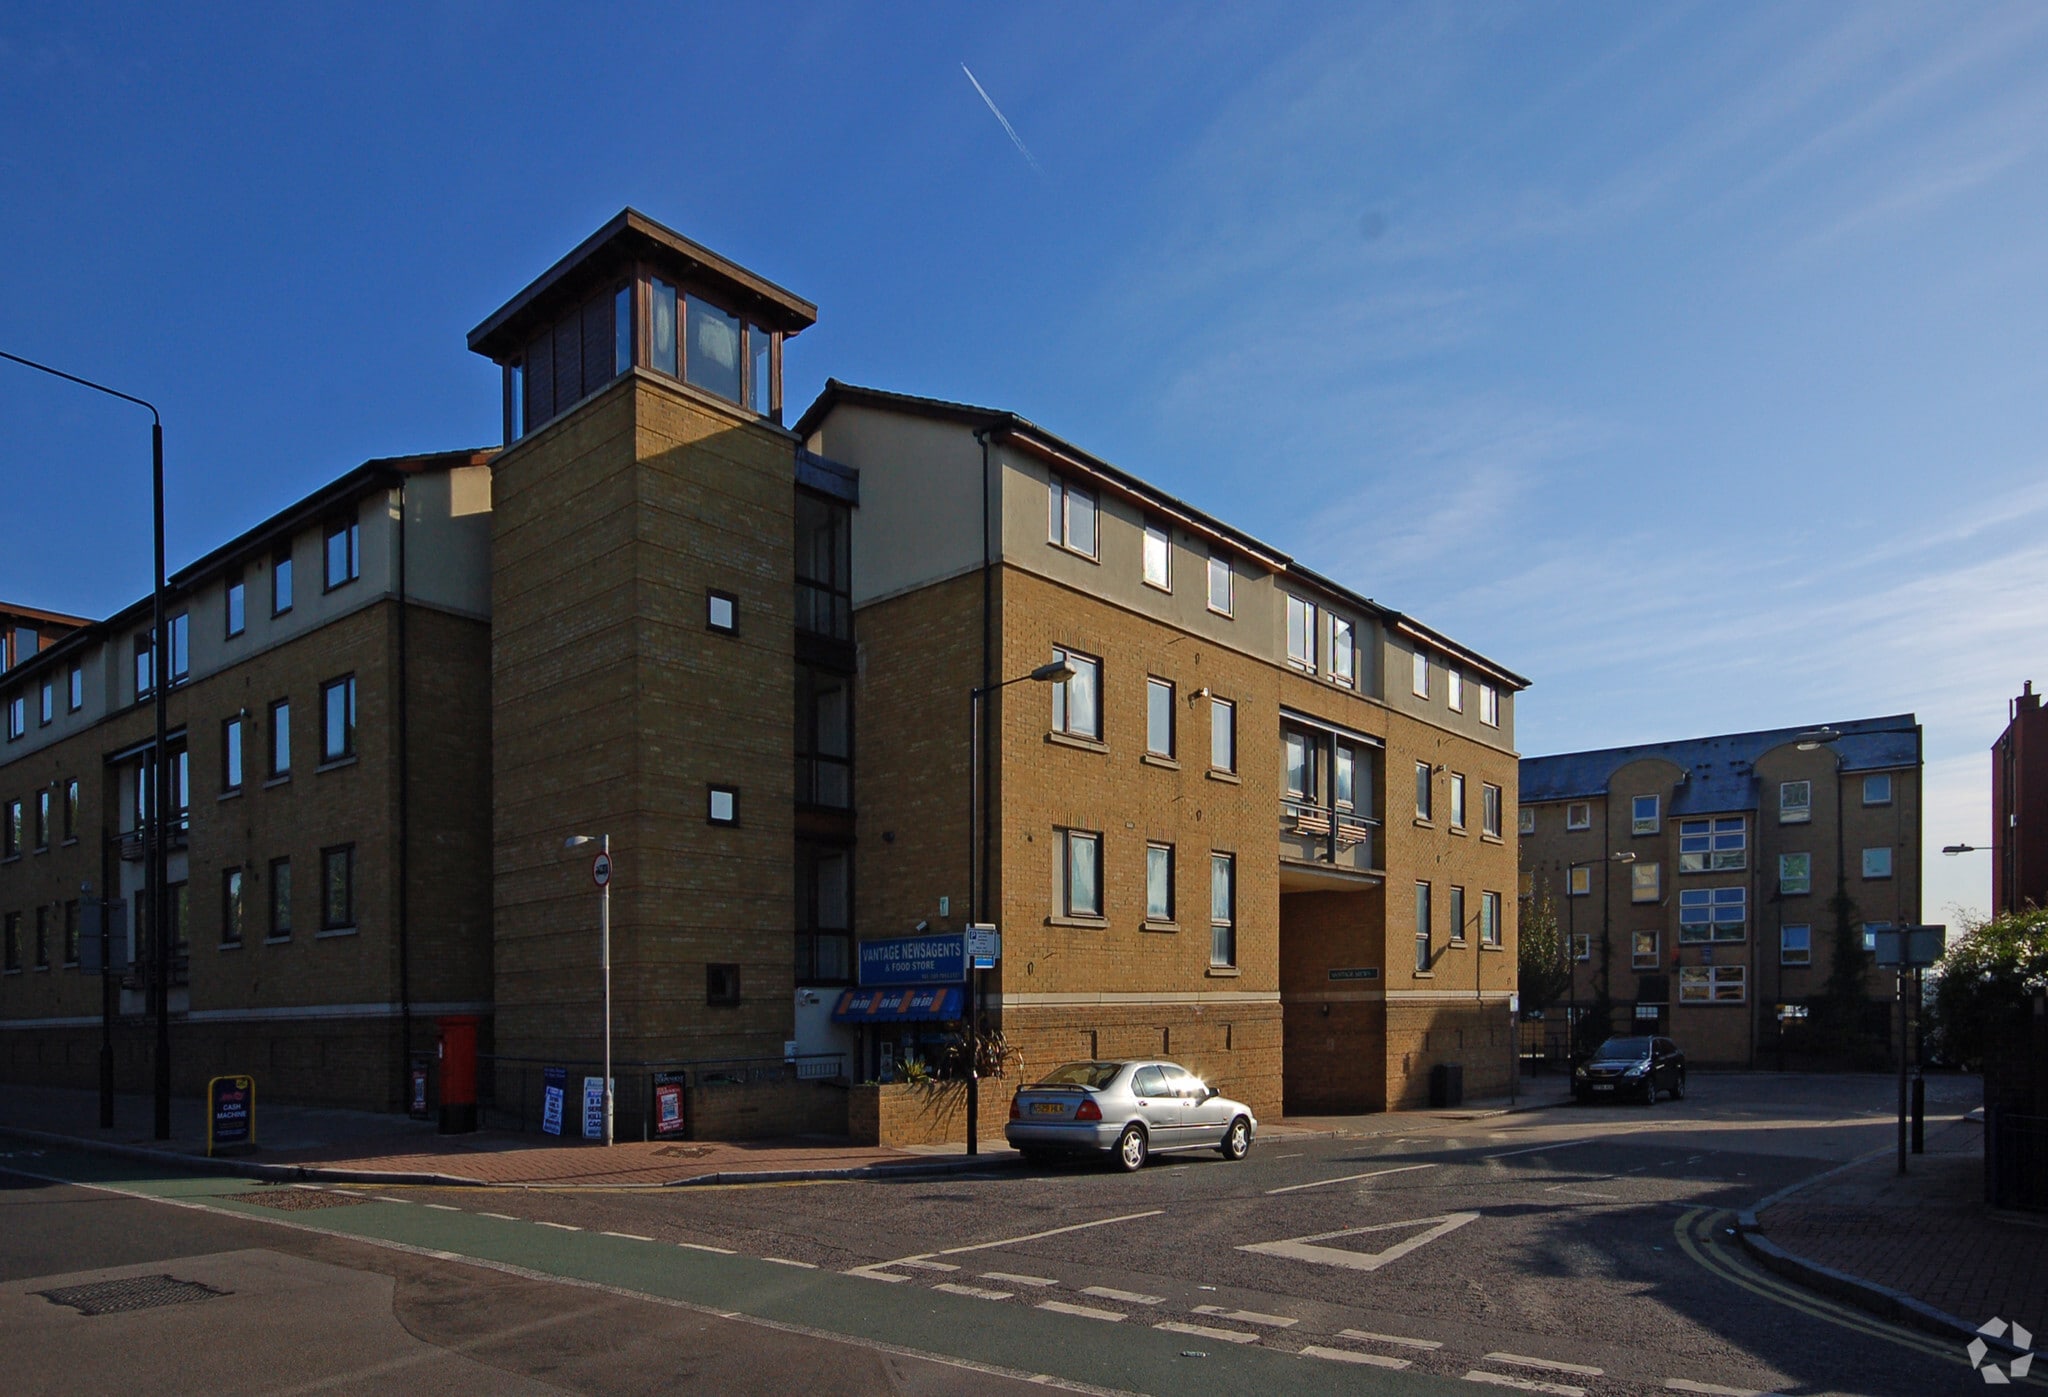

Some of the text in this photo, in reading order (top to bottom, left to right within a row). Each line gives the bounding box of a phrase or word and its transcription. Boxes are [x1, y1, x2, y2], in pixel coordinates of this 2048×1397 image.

[862, 942, 961, 962] VANTAGE NEWSAGENTS
[892, 962, 911, 972] FOOD
[912, 960, 935, 971] STORE
[223, 1103, 241, 1111] CASH
[217, 1110, 247, 1119] MACHINE
